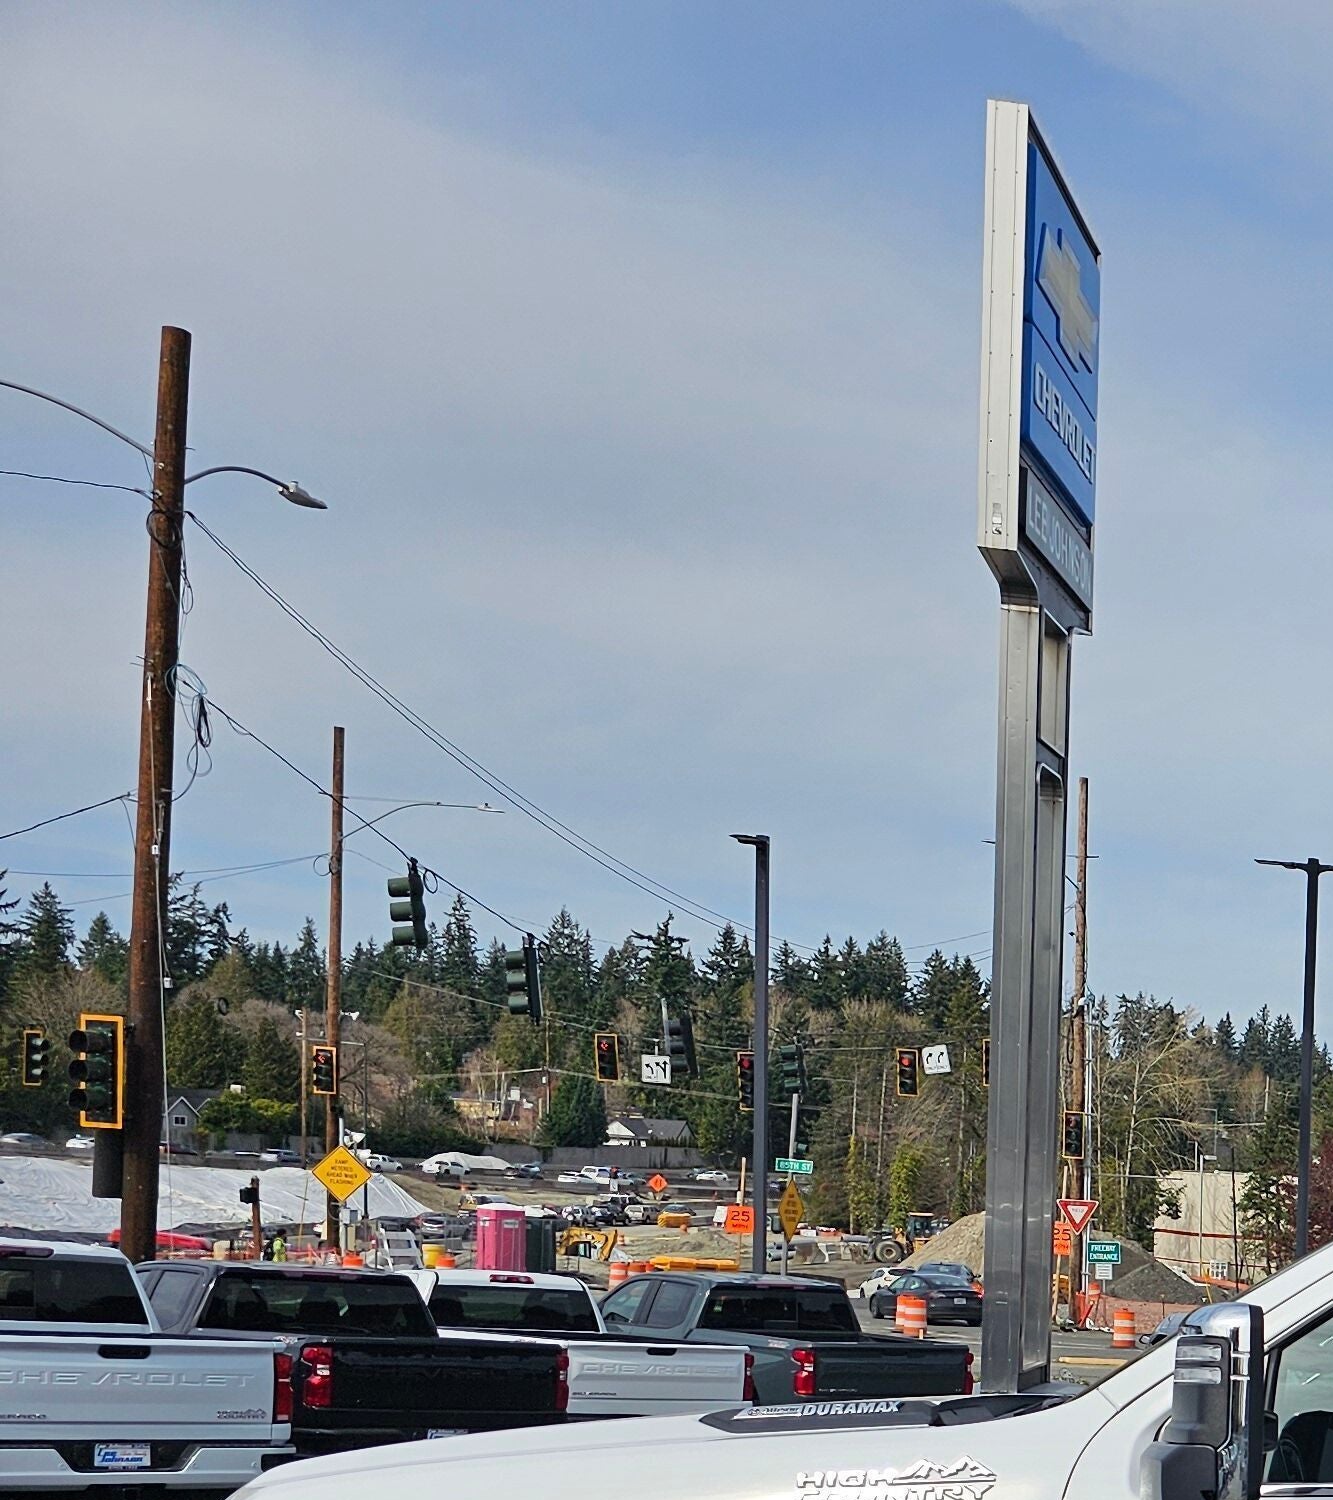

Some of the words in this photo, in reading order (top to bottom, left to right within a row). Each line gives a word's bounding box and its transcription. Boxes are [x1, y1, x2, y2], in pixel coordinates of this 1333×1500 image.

[1033, 362, 1094, 485] CHEVROLET
[1028, 484, 1048, 542] LEE
[1051, 513, 1092, 596] JOHNSON
[801, 1163, 811, 1171] ST
[731, 1210, 751, 1223] 25
[801, 1400, 902, 1416] DURAMAX
[795, 1468, 897, 1489] HIGH
